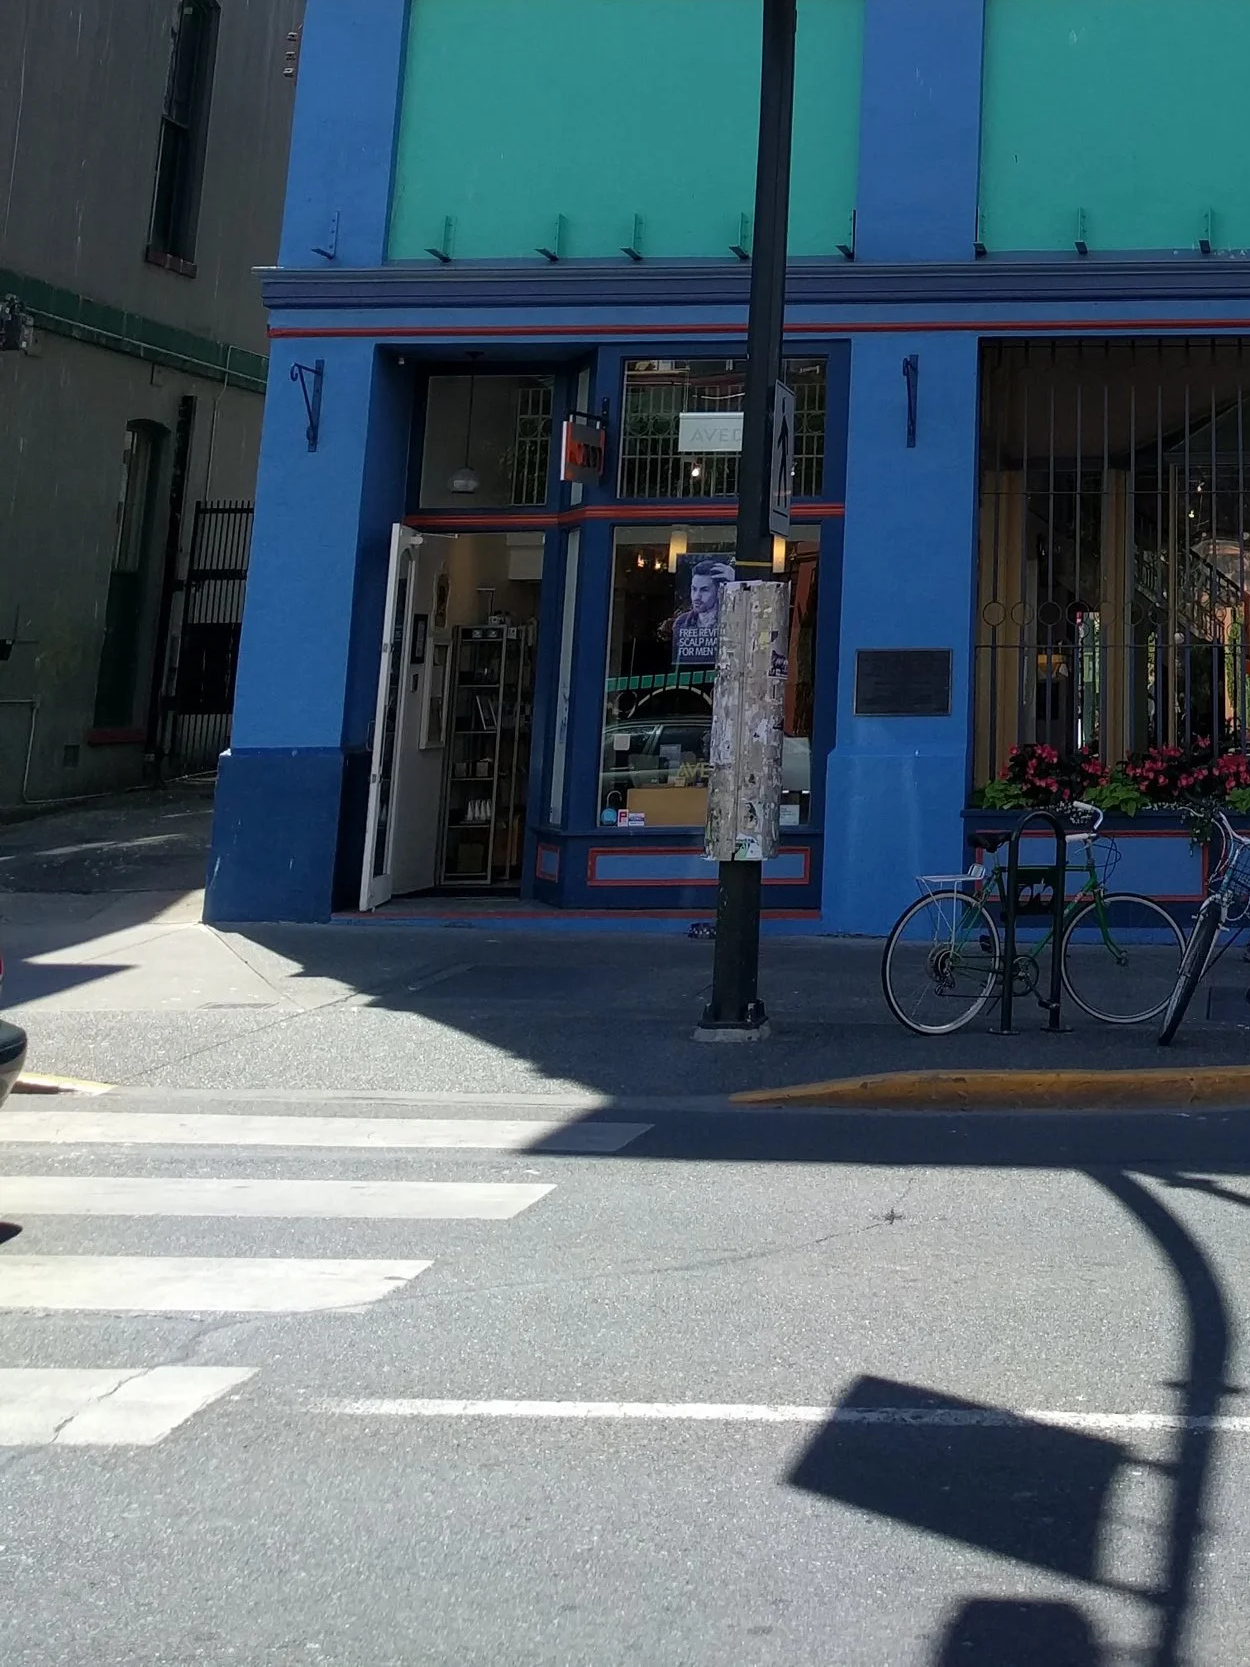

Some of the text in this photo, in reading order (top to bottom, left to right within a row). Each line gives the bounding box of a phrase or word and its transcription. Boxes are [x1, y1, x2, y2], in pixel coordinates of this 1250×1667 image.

[679, 628, 698, 637] FREE
[679, 637, 705, 647] SCALP
[679, 647, 694, 656] FOR
